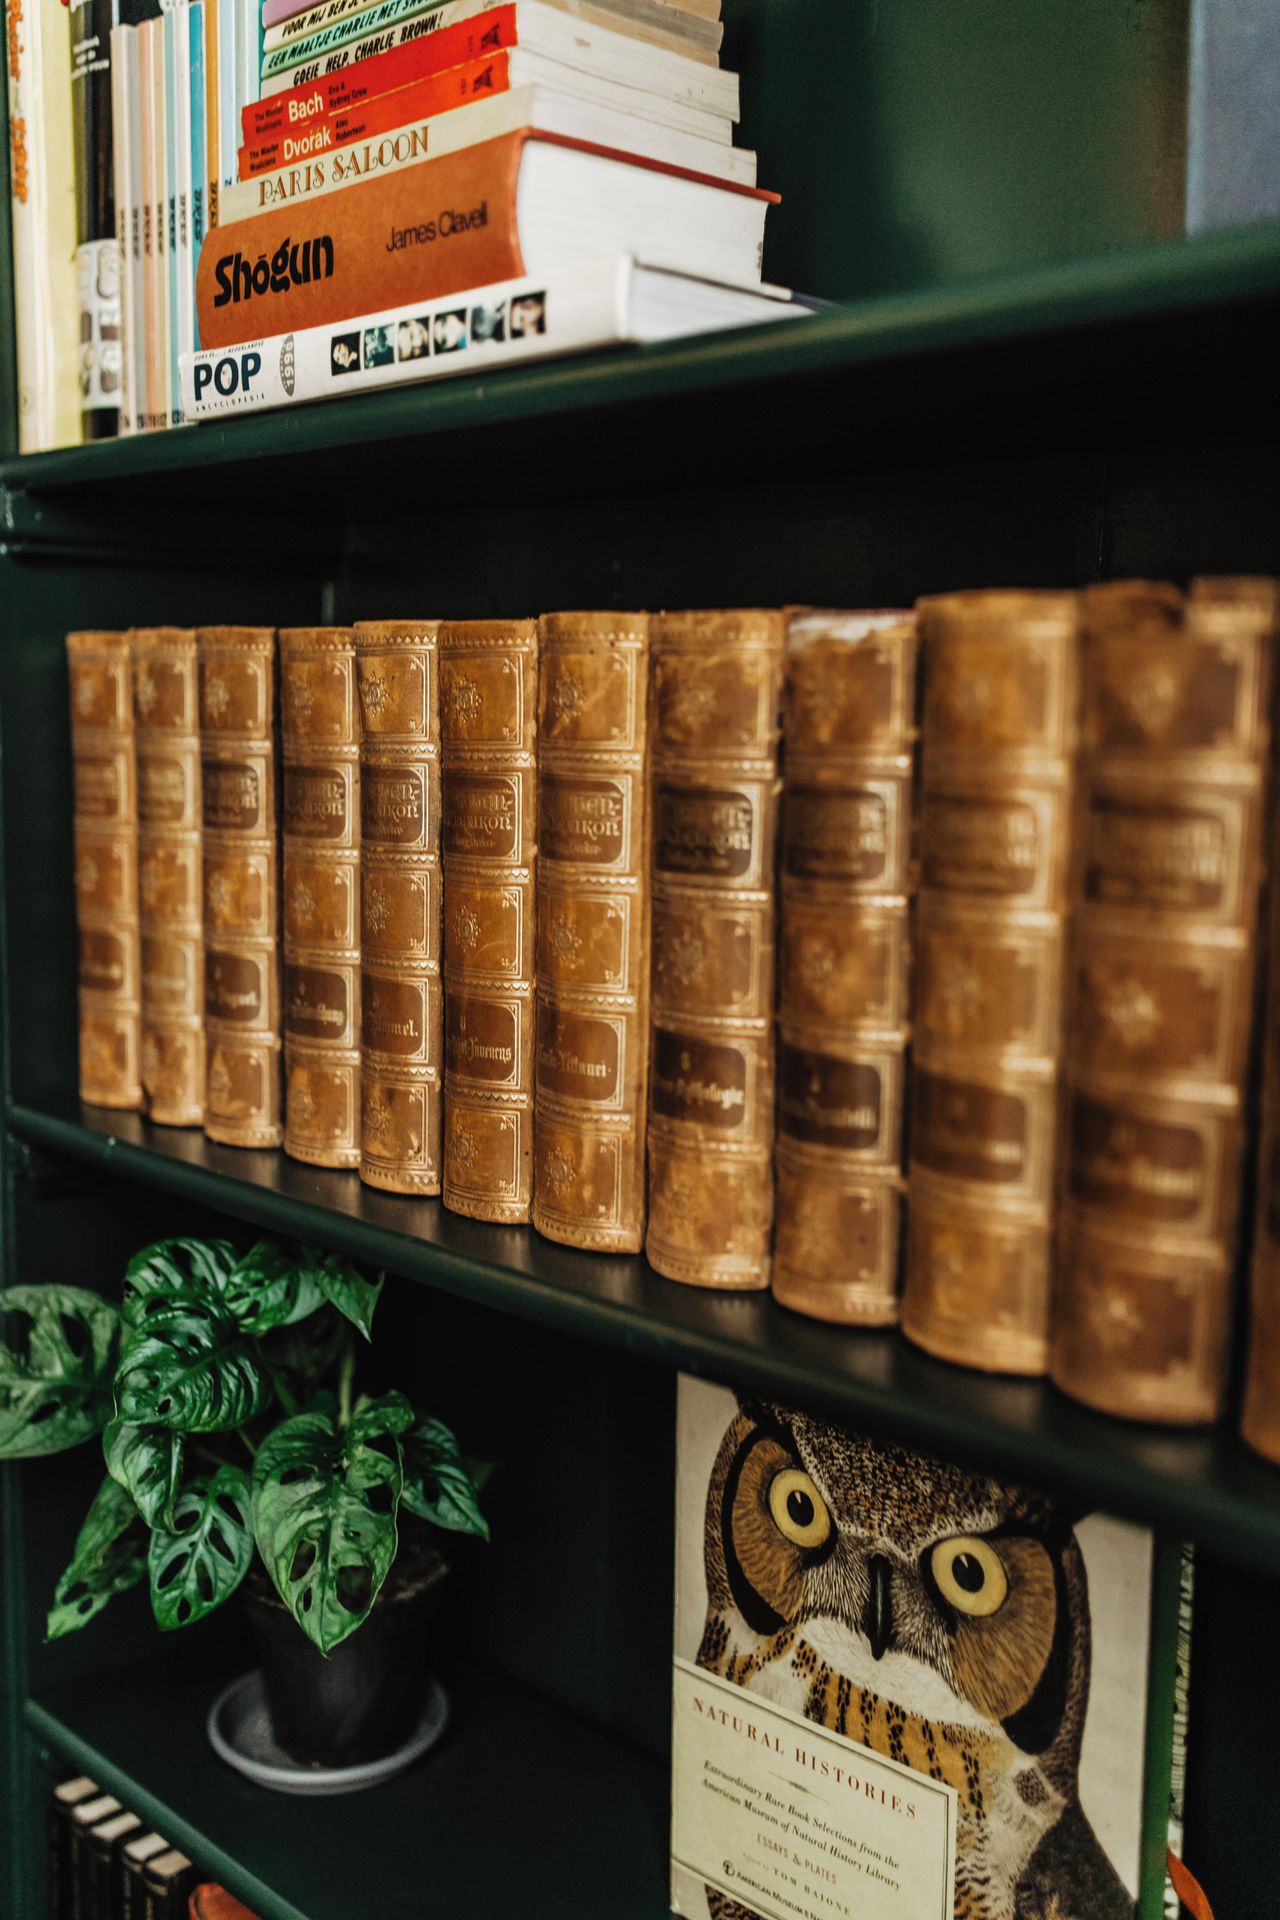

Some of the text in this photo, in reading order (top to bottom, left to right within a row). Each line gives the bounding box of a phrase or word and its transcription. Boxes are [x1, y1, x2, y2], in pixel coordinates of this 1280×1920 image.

[267, 49, 288, 69] EEN
[287, 30, 333, 61] MAALTJE
[332, 9, 378, 41] CHARLIE
[377, 0, 402, 21] MET
[282, 15, 307, 38] VOOR
[307, 7, 327, 27] MIJ
[327, 0, 347, 18] BEN
[293, 67, 319, 87] GOEIE
[354, 31, 396, 61] CHARLIE
[400, 12, 443, 43] BROWN!
[288, 91, 324, 122] Bach
[258, 124, 431, 207] PARIS SALOON
[283, 125, 332, 161] Dvořák
[385, 200, 489, 253] James Clavell
[214, 234, 335, 308] Shōgun
[193, 352, 262, 402] POP
[195, 392, 266, 413] ENCYCLOPEDIE
[693, 1697, 916, 1819] NATURAL HISTORIES
[702, 1778, 901, 1893] American Museum of Natural History Library
[703, 1760, 900, 1869] Extraordinary Rare Book Selections from the
[757, 1833, 837, 1885] ESSAYS & PLATES
[774, 1868, 797, 1886] TOM
